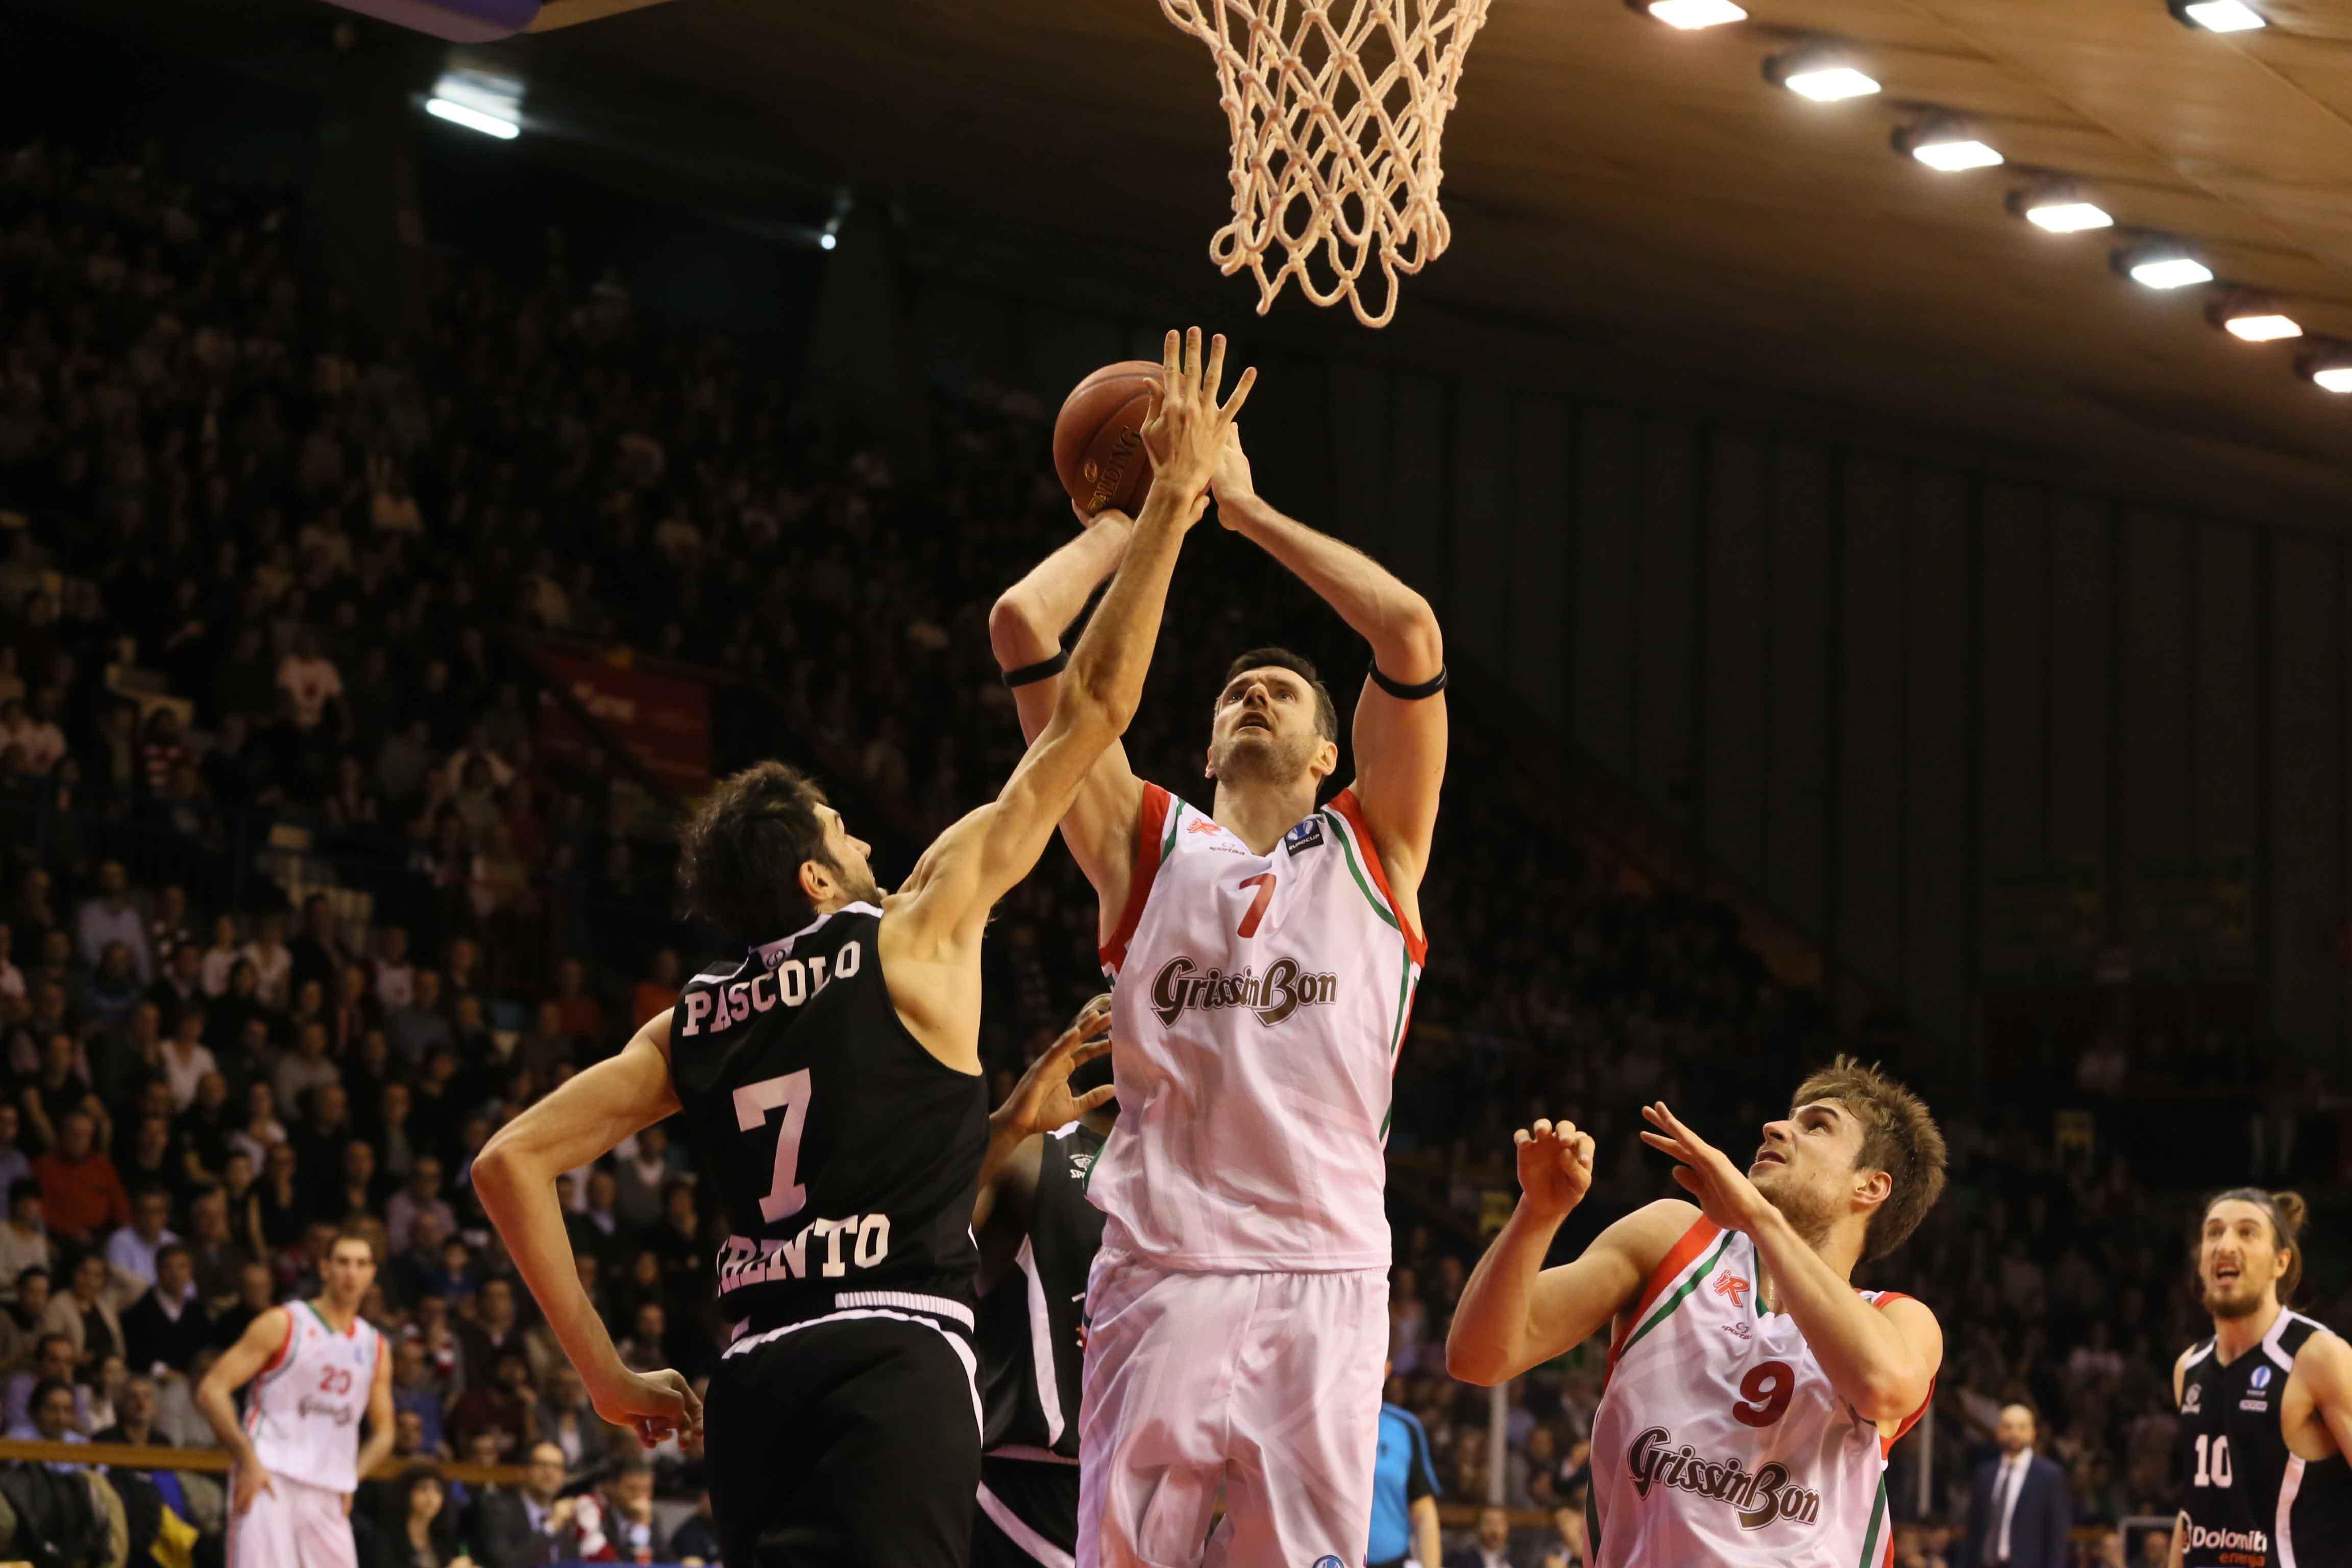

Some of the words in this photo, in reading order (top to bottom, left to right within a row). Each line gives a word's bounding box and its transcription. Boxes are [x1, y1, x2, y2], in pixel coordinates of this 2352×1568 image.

[1289, 833, 1320, 850] EUROCUP
[1237, 873, 1277, 938] 7
[682, 940, 861, 1037] PASCOLO
[1151, 955, 1339, 1030] GrissinBon
[732, 1067, 812, 1225] 7
[1733, 1361, 1795, 1428] 9
[1627, 1426, 1821, 1531] GrissinBon
[2193, 1433, 2233, 1489] 10
